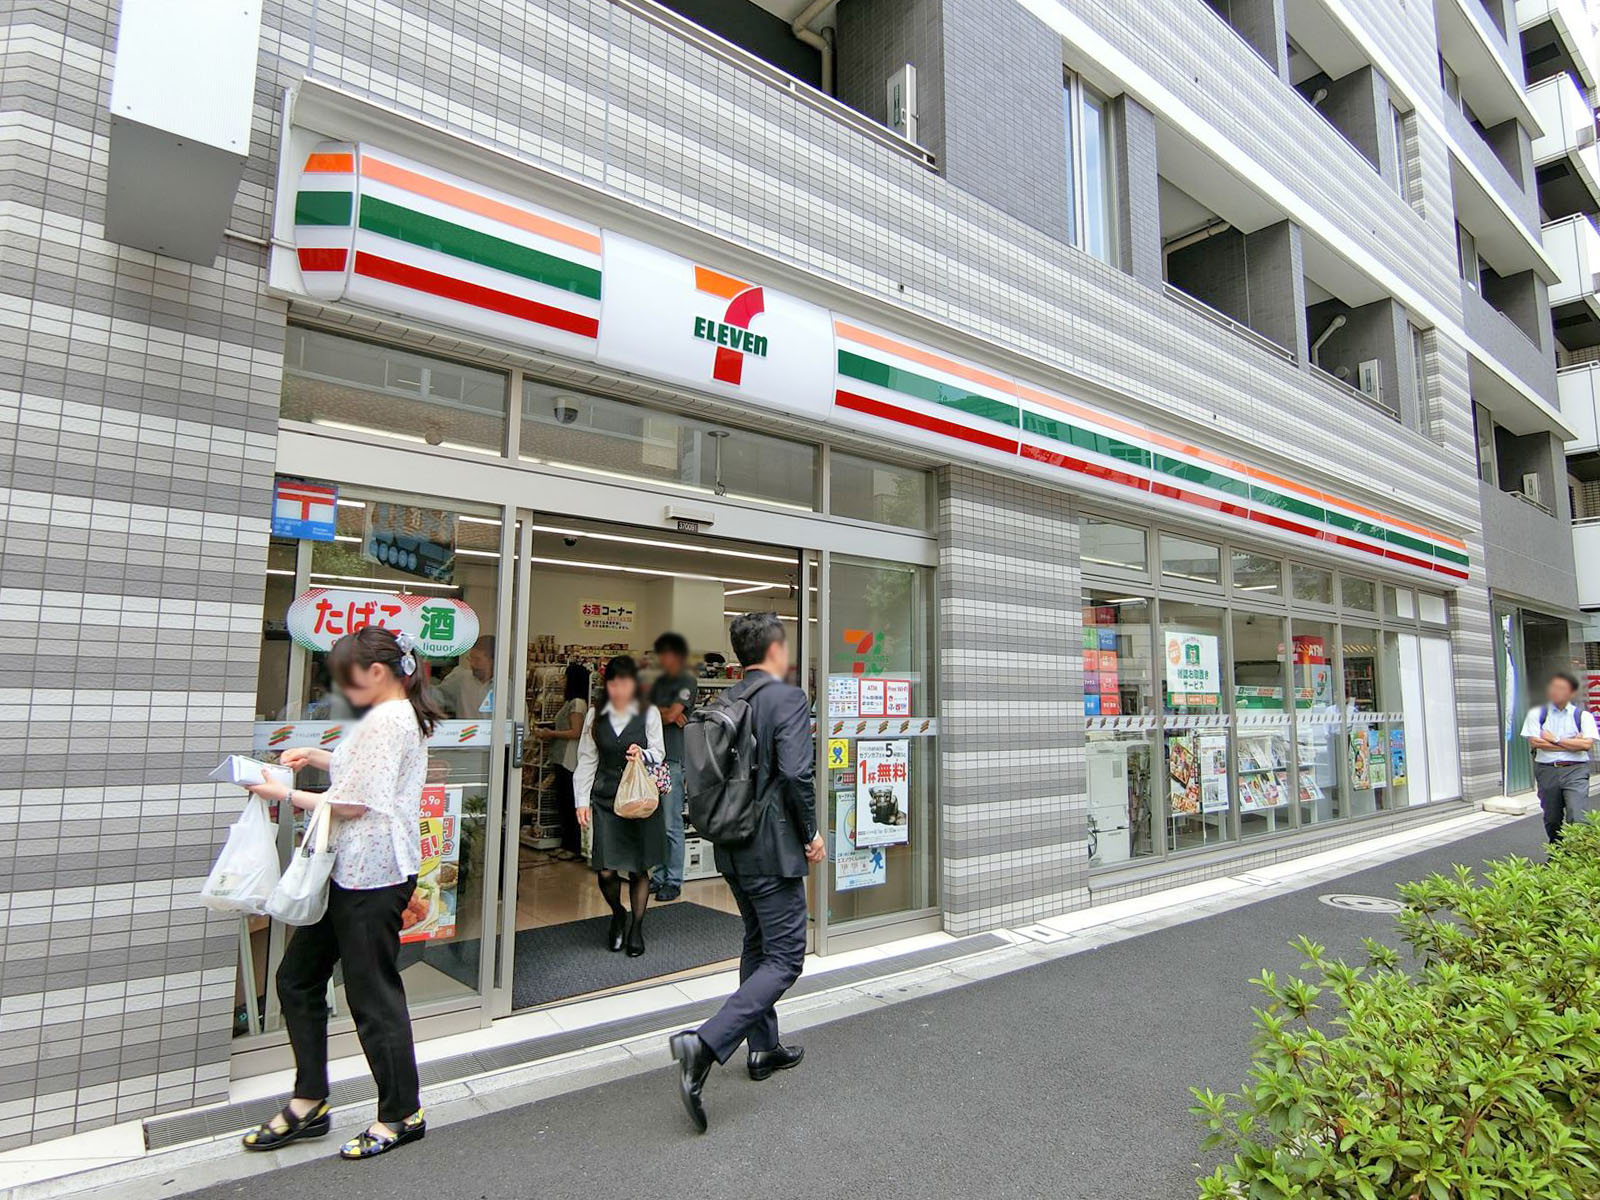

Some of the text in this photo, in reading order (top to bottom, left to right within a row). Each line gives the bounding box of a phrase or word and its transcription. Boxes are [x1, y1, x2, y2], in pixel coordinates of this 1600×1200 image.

[582, 604, 633, 616] お酒コーナー
[420, 605, 456, 641] 酒
[422, 643, 454, 655] liquor
